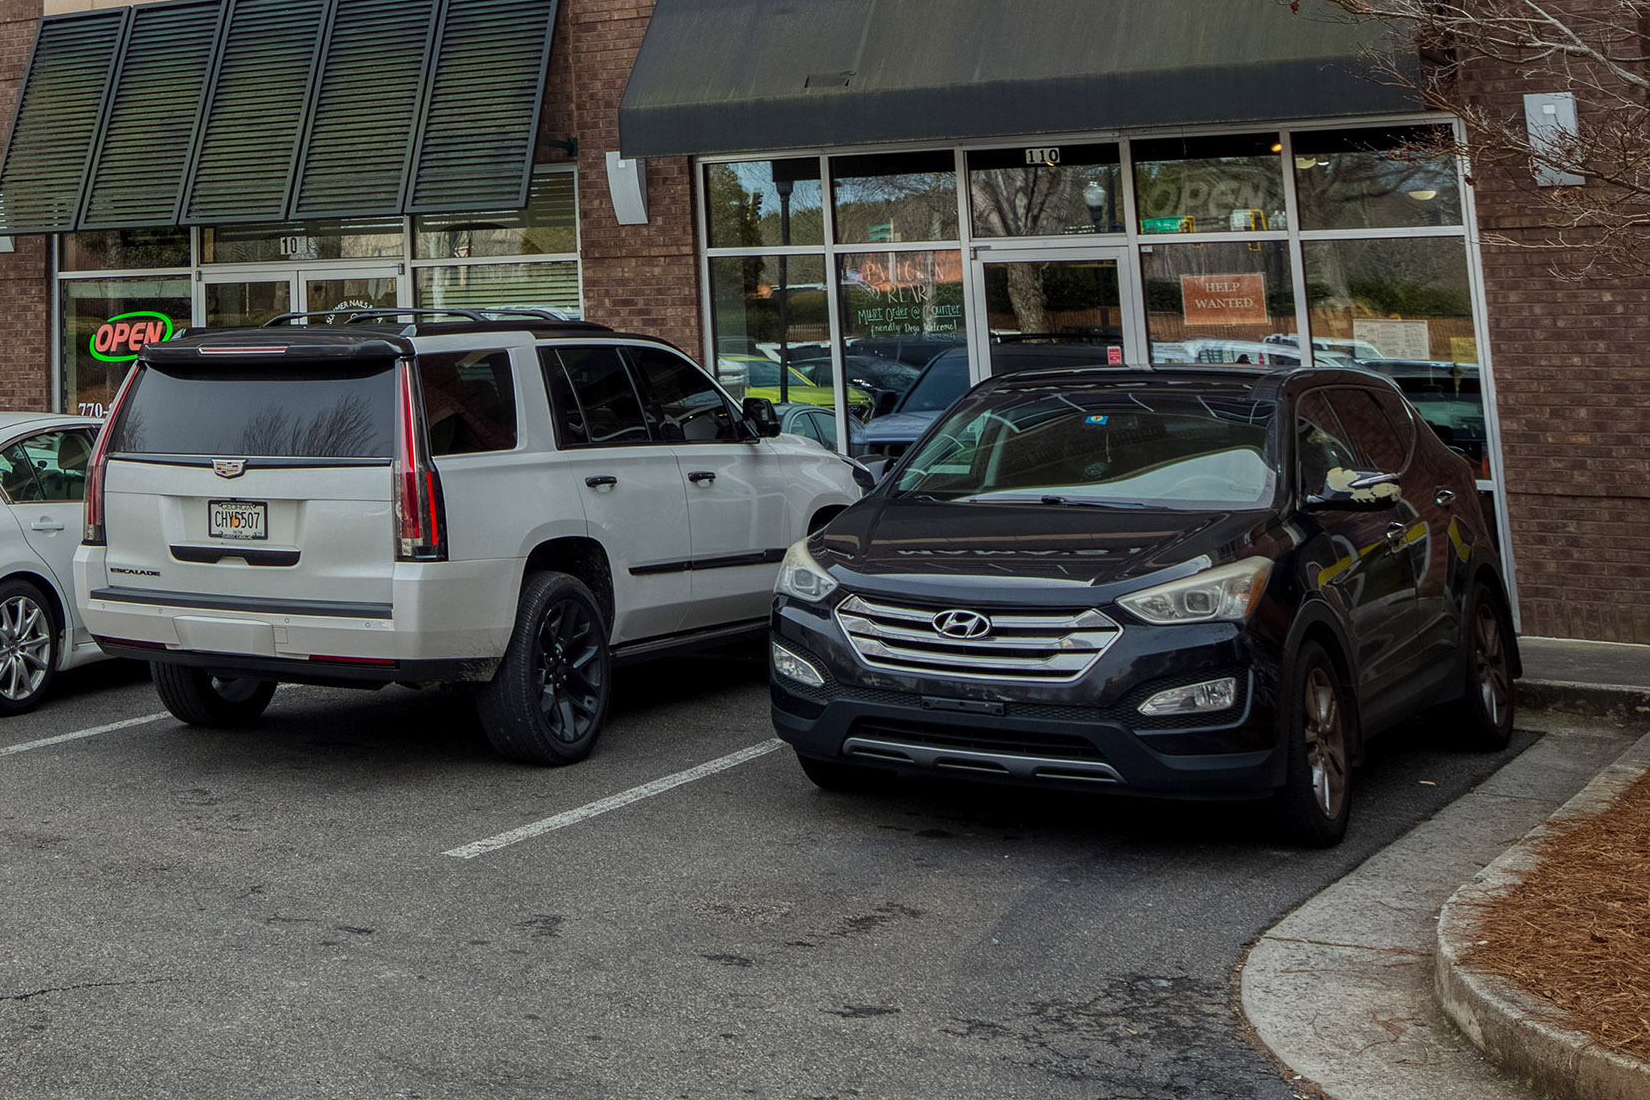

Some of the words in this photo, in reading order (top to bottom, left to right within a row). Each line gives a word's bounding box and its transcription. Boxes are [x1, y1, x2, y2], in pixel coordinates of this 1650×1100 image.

[1027, 149, 1059, 162] 110
[281, 237, 305, 254] 10
[1205, 282, 1240, 293] HELP
[349, 299, 370, 309] NAILS
[1194, 297, 1254, 309] WANTED
[95, 321, 164, 352] OPEN
[78, 402, 113, 419] 770-
[214, 510, 261, 530] CHY5507
[110, 567, 161, 577] ESCALADE
